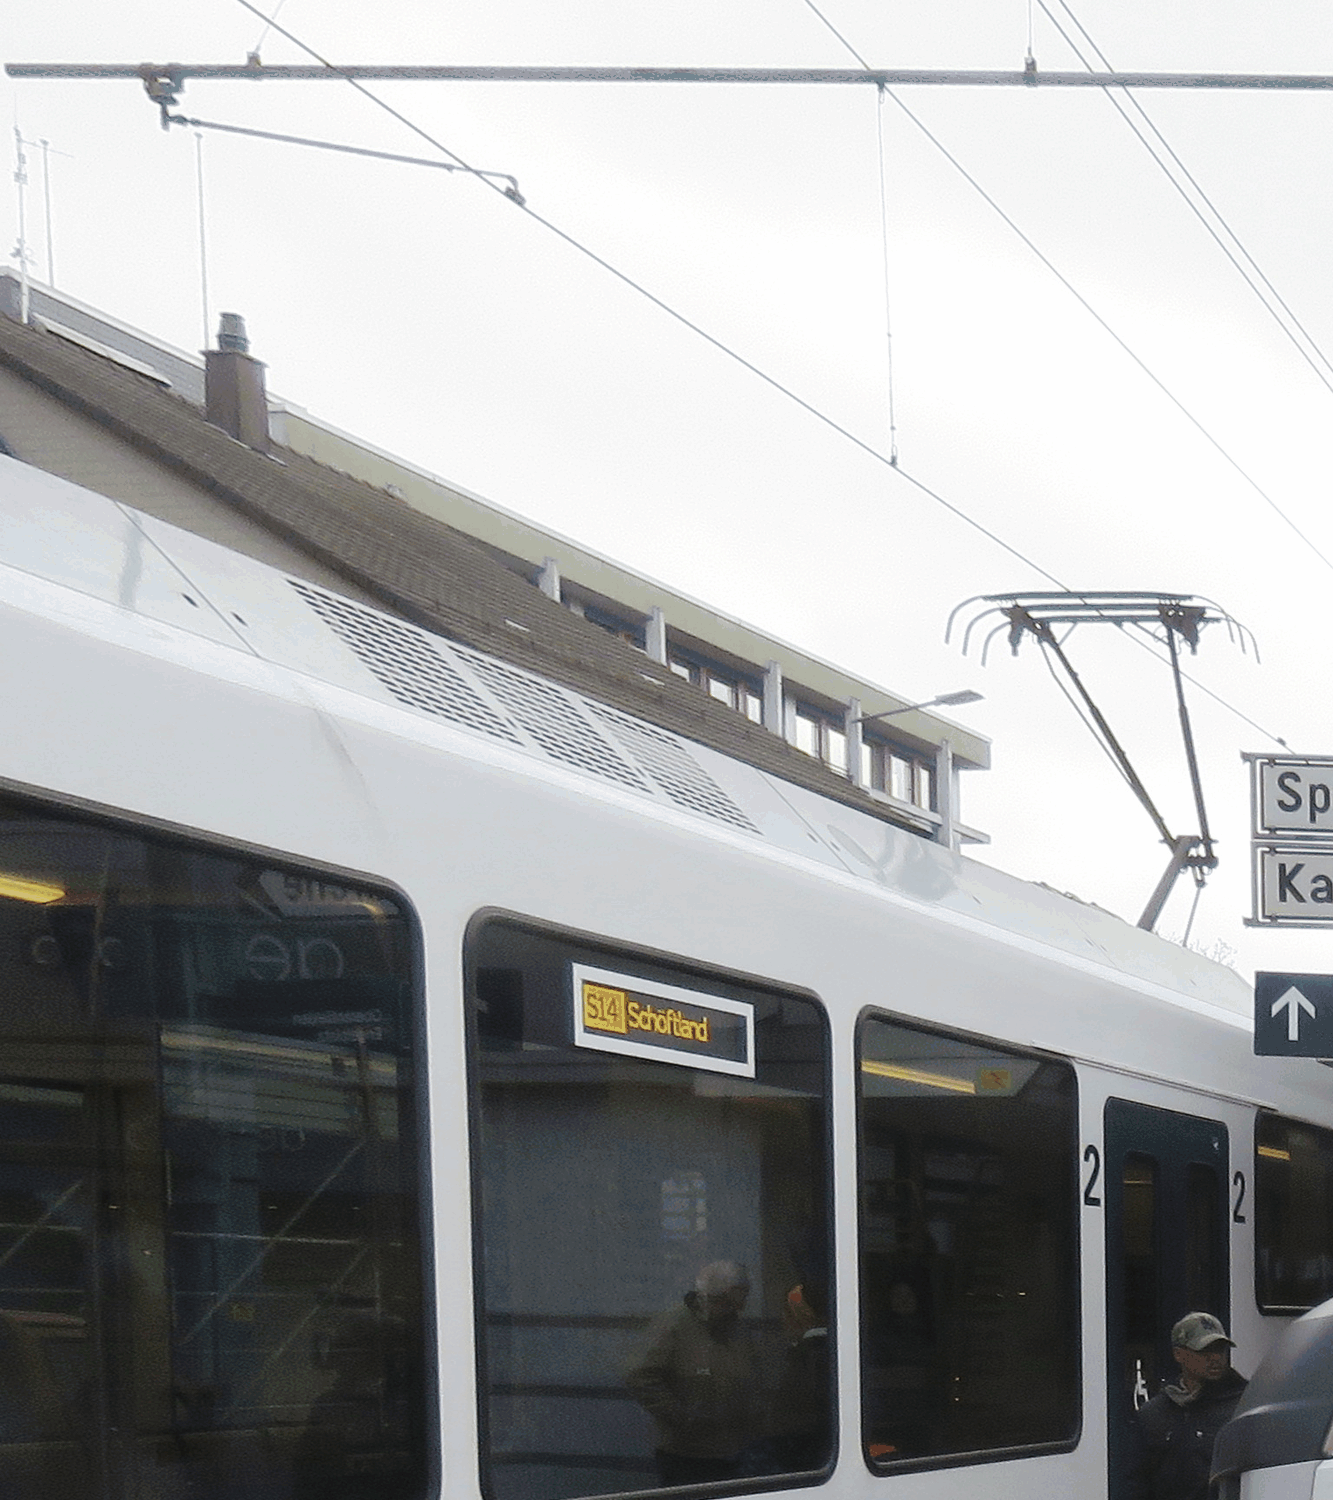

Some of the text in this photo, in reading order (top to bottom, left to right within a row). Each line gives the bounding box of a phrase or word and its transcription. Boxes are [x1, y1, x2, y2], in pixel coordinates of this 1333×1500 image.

[586, 993, 709, 1042] S14 Schöftland
[1084, 1144, 1101, 1207] 2
[1233, 1170, 1246, 1223] 2
